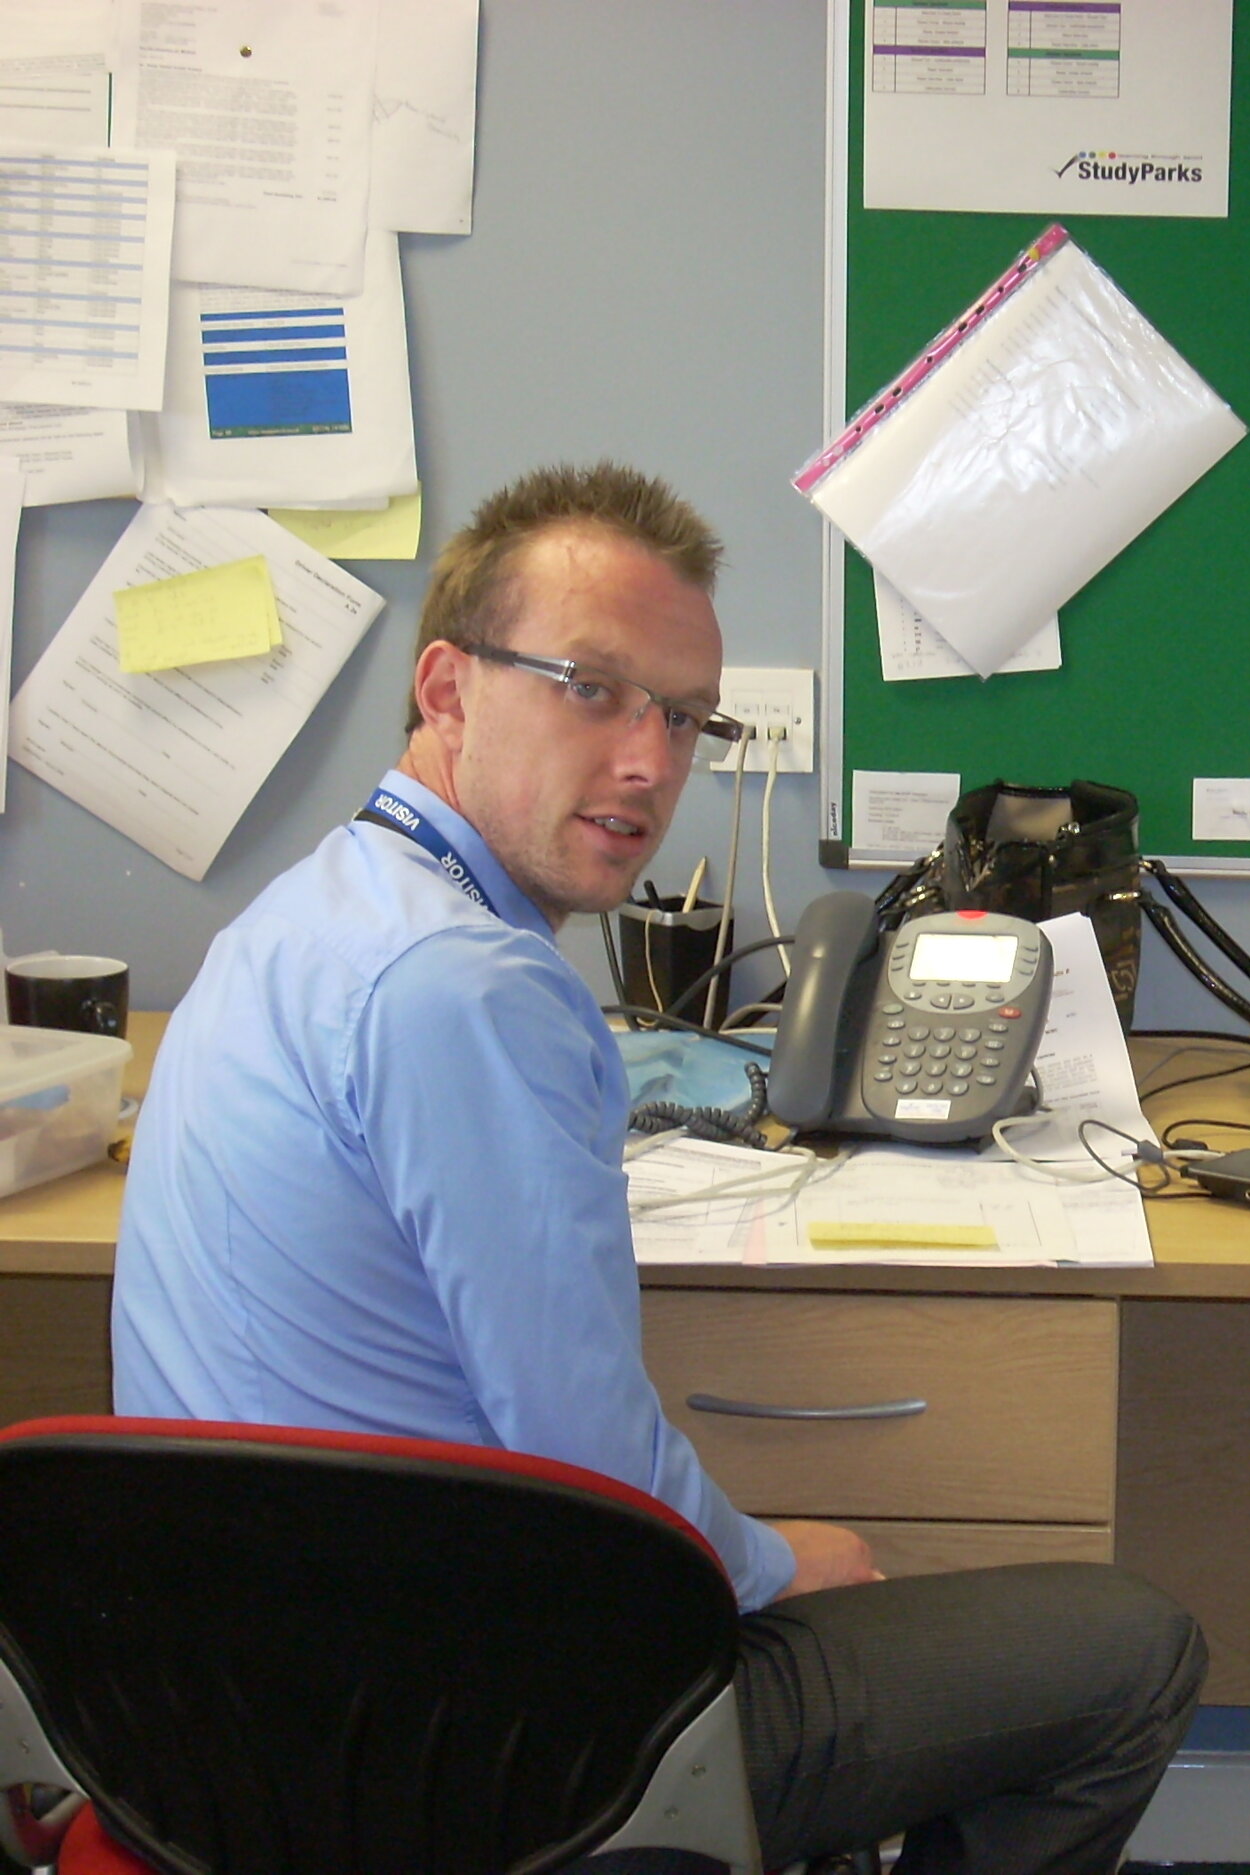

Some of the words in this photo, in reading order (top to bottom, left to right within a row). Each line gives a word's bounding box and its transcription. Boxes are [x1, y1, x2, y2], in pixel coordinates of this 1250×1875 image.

[1078, 161, 1203, 184] StudyParks
[374, 793, 421, 832] VISITOR
[440, 851, 489, 911] SITOR
